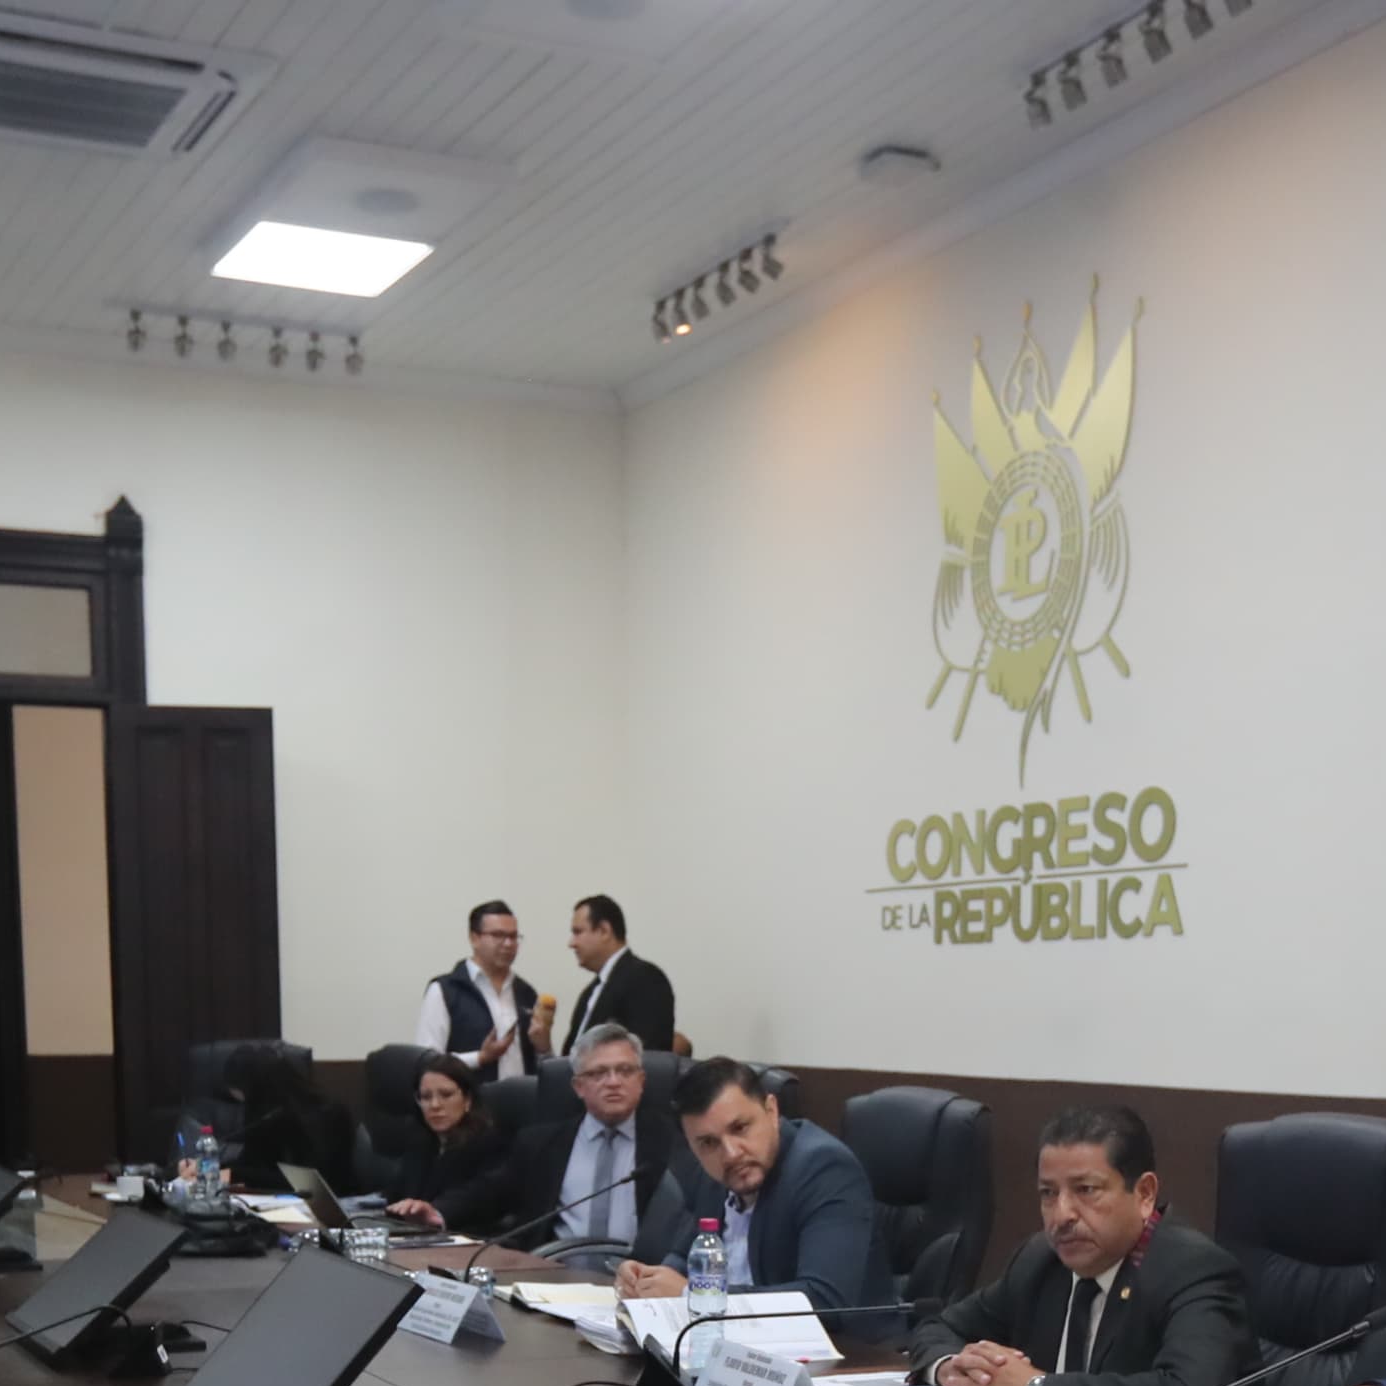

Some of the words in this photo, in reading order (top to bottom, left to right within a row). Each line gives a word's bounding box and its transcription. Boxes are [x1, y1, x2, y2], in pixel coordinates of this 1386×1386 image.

[886, 786, 1177, 883] CONGRESO
[881, 905, 903, 931] DE
[909, 903, 931, 929] LA
[935, 871, 1184, 945] REPÚBLICA
